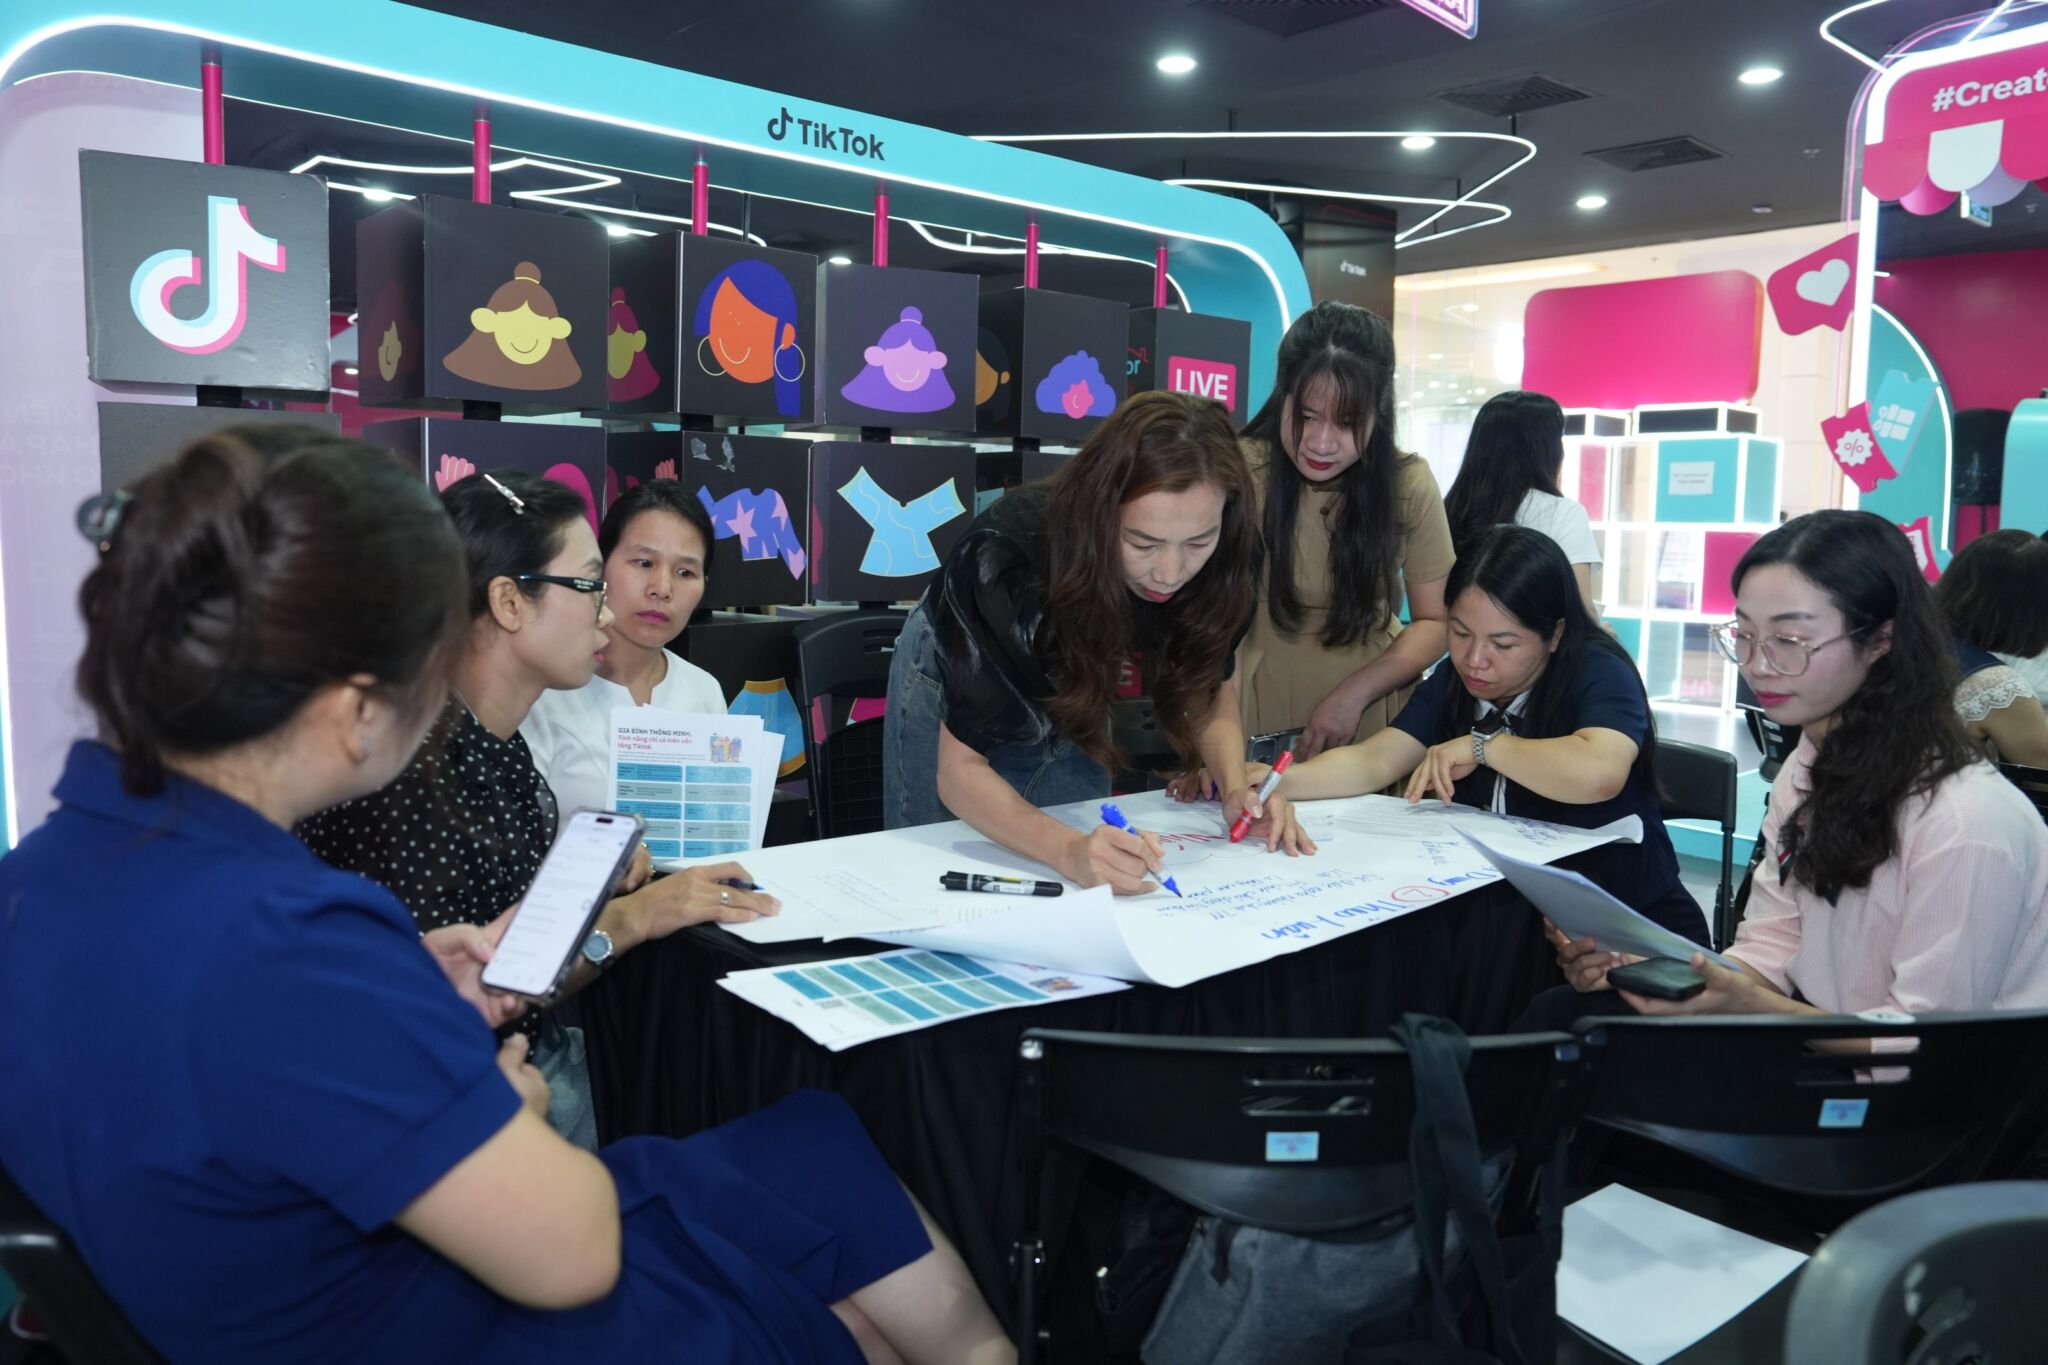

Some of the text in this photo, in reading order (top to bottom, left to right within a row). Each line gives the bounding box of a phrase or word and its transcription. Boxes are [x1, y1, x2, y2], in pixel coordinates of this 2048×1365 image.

[1931, 67, 2048, 112] #Creat
[797, 118, 886, 161] TikTok
[1175, 368, 1228, 401] LIVE
[649, 728, 671, 736] THÔNG
